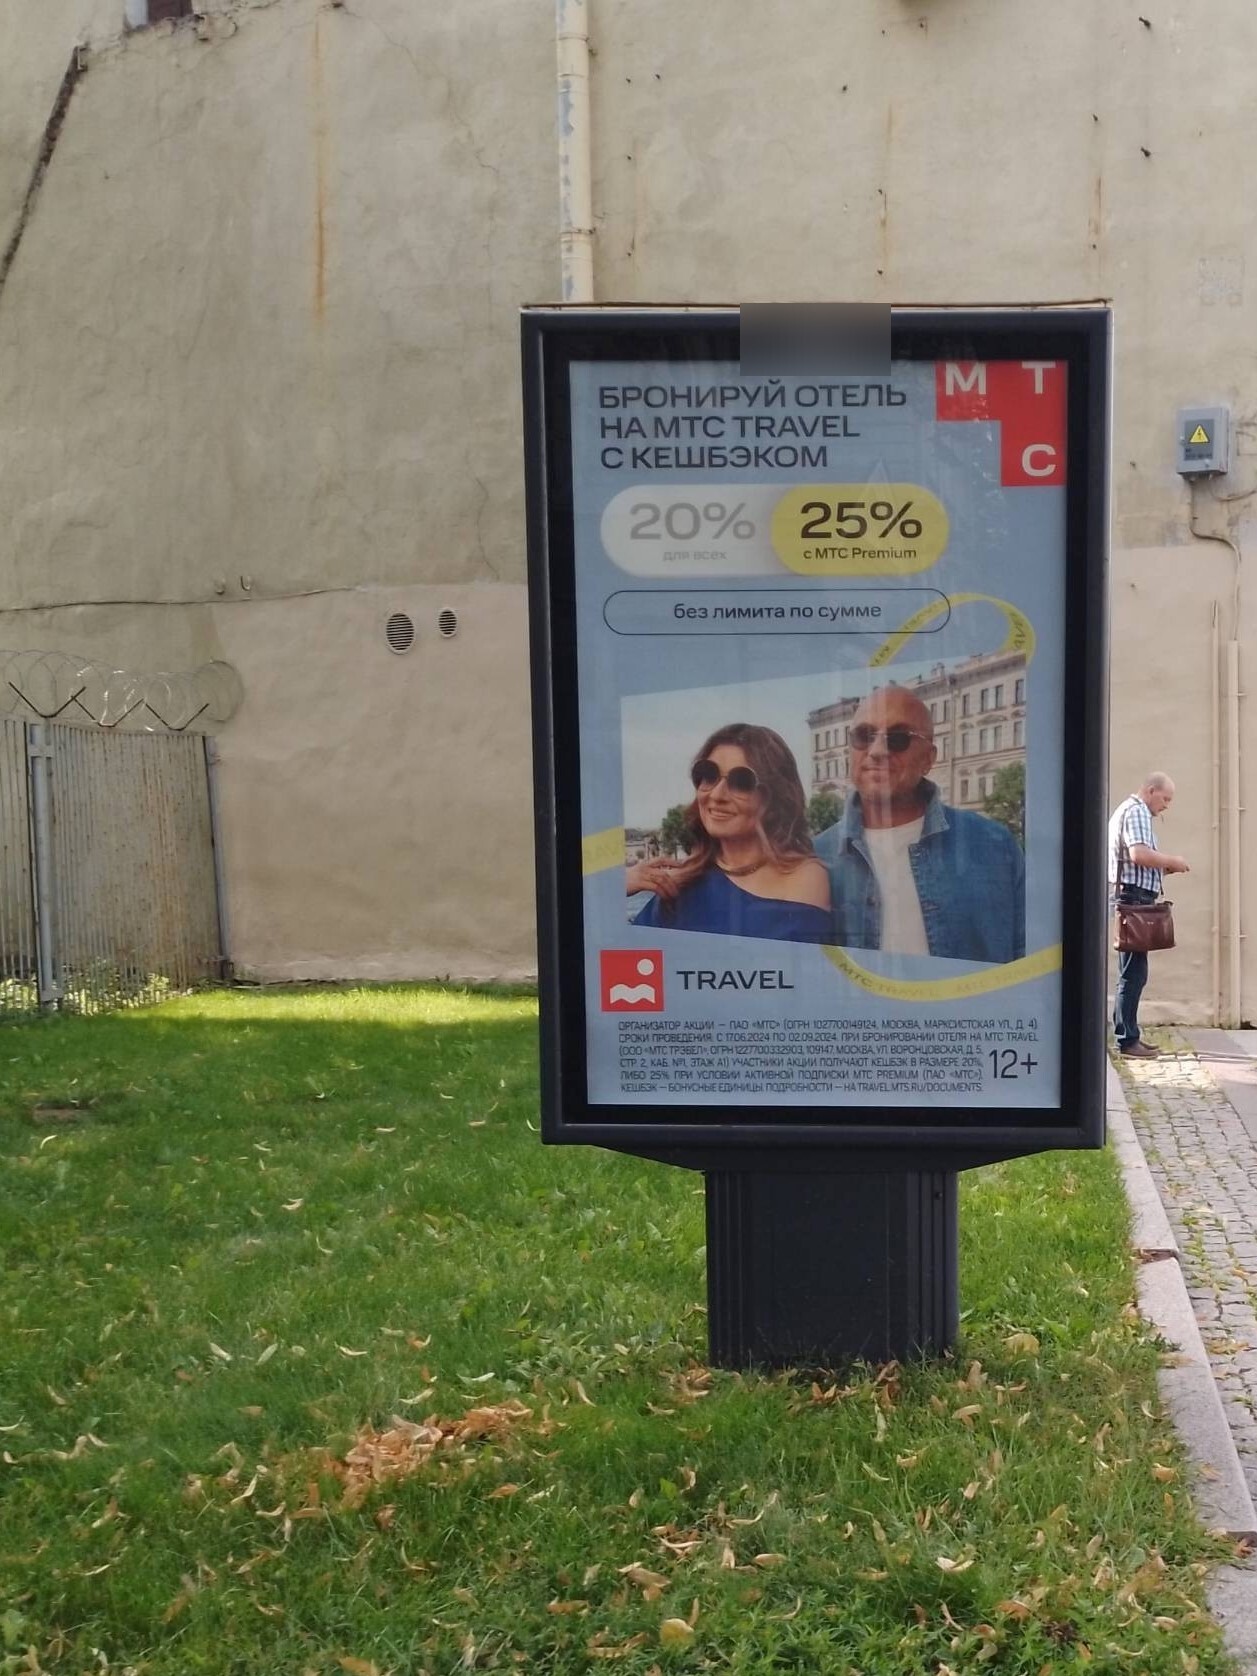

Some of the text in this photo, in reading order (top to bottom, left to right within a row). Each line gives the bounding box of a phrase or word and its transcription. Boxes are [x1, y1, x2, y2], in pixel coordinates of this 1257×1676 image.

[599, 378, 907, 408] БРОНИРУЙ ОТЕЛЬ
[600, 415, 861, 439] НА МТС TRAVEL
[600, 445, 828, 469] С КЕШБЭКОМ
[629, 502, 756, 540] 20%
[800, 501, 922, 539] 25%
[662, 551, 728, 562] для всех
[803, 547, 917, 559] с МТС Premium
[673, 603, 882, 621] без лимита по сумме
[676, 970, 795, 990] TRAVEL
[619, 1021, 681, 1030] ОРГАНИЗАТОР
[684, 1020, 714, 1030] АКЦИИ
[730, 1020, 749, 1029] ПАО
[619, 1033, 649, 1043] СРОКИ
[773, 1032, 786, 1042] ПО
[842, 1032, 859, 1042] ПРИ
[863, 1032, 935, 1042] БРОНИРОВАНИИ
[938, 1032, 967, 1041] ОТЕЛЯ
[970, 1032, 982, 1041] НА
[985, 1032, 1004, 1041] МТС
[1006, 1032, 1038, 1041] TRAVEL
[710, 1045, 733, 1055] ОГРН
[690, 1058, 715, 1067] ЭТАЖ
[732, 1057, 784, 1067] УЧАСТНИКИ
[787, 1057, 817, 1067] АКЦИИ
[820, 1057, 869, 1066] ПОЛУЧАЮТ
[910, 1057, 917, 1066] В
[919, 1057, 959, 1066] РАЗМЕРЕ
[989, 1049, 1038, 1079] 12+
[620, 1070, 646, 1080] ЛИБО
[674, 1070, 693, 1080] ПРИ
[696, 1070, 740, 1080] УСЛОВИИ
[745, 1068, 794, 1080] АКТИВНОЙ
[798, 1070, 849, 1080] ПОДПИСКИ
[853, 1070, 873, 1079] МТС
[876, 1070, 918, 1079] PREMIUM
[668, 1083, 717, 1092] БОНУСНЫЕ
[766, 1083, 833, 1092] ПОДРОБНОСТИ
[844, 1083, 856, 1092] НА
